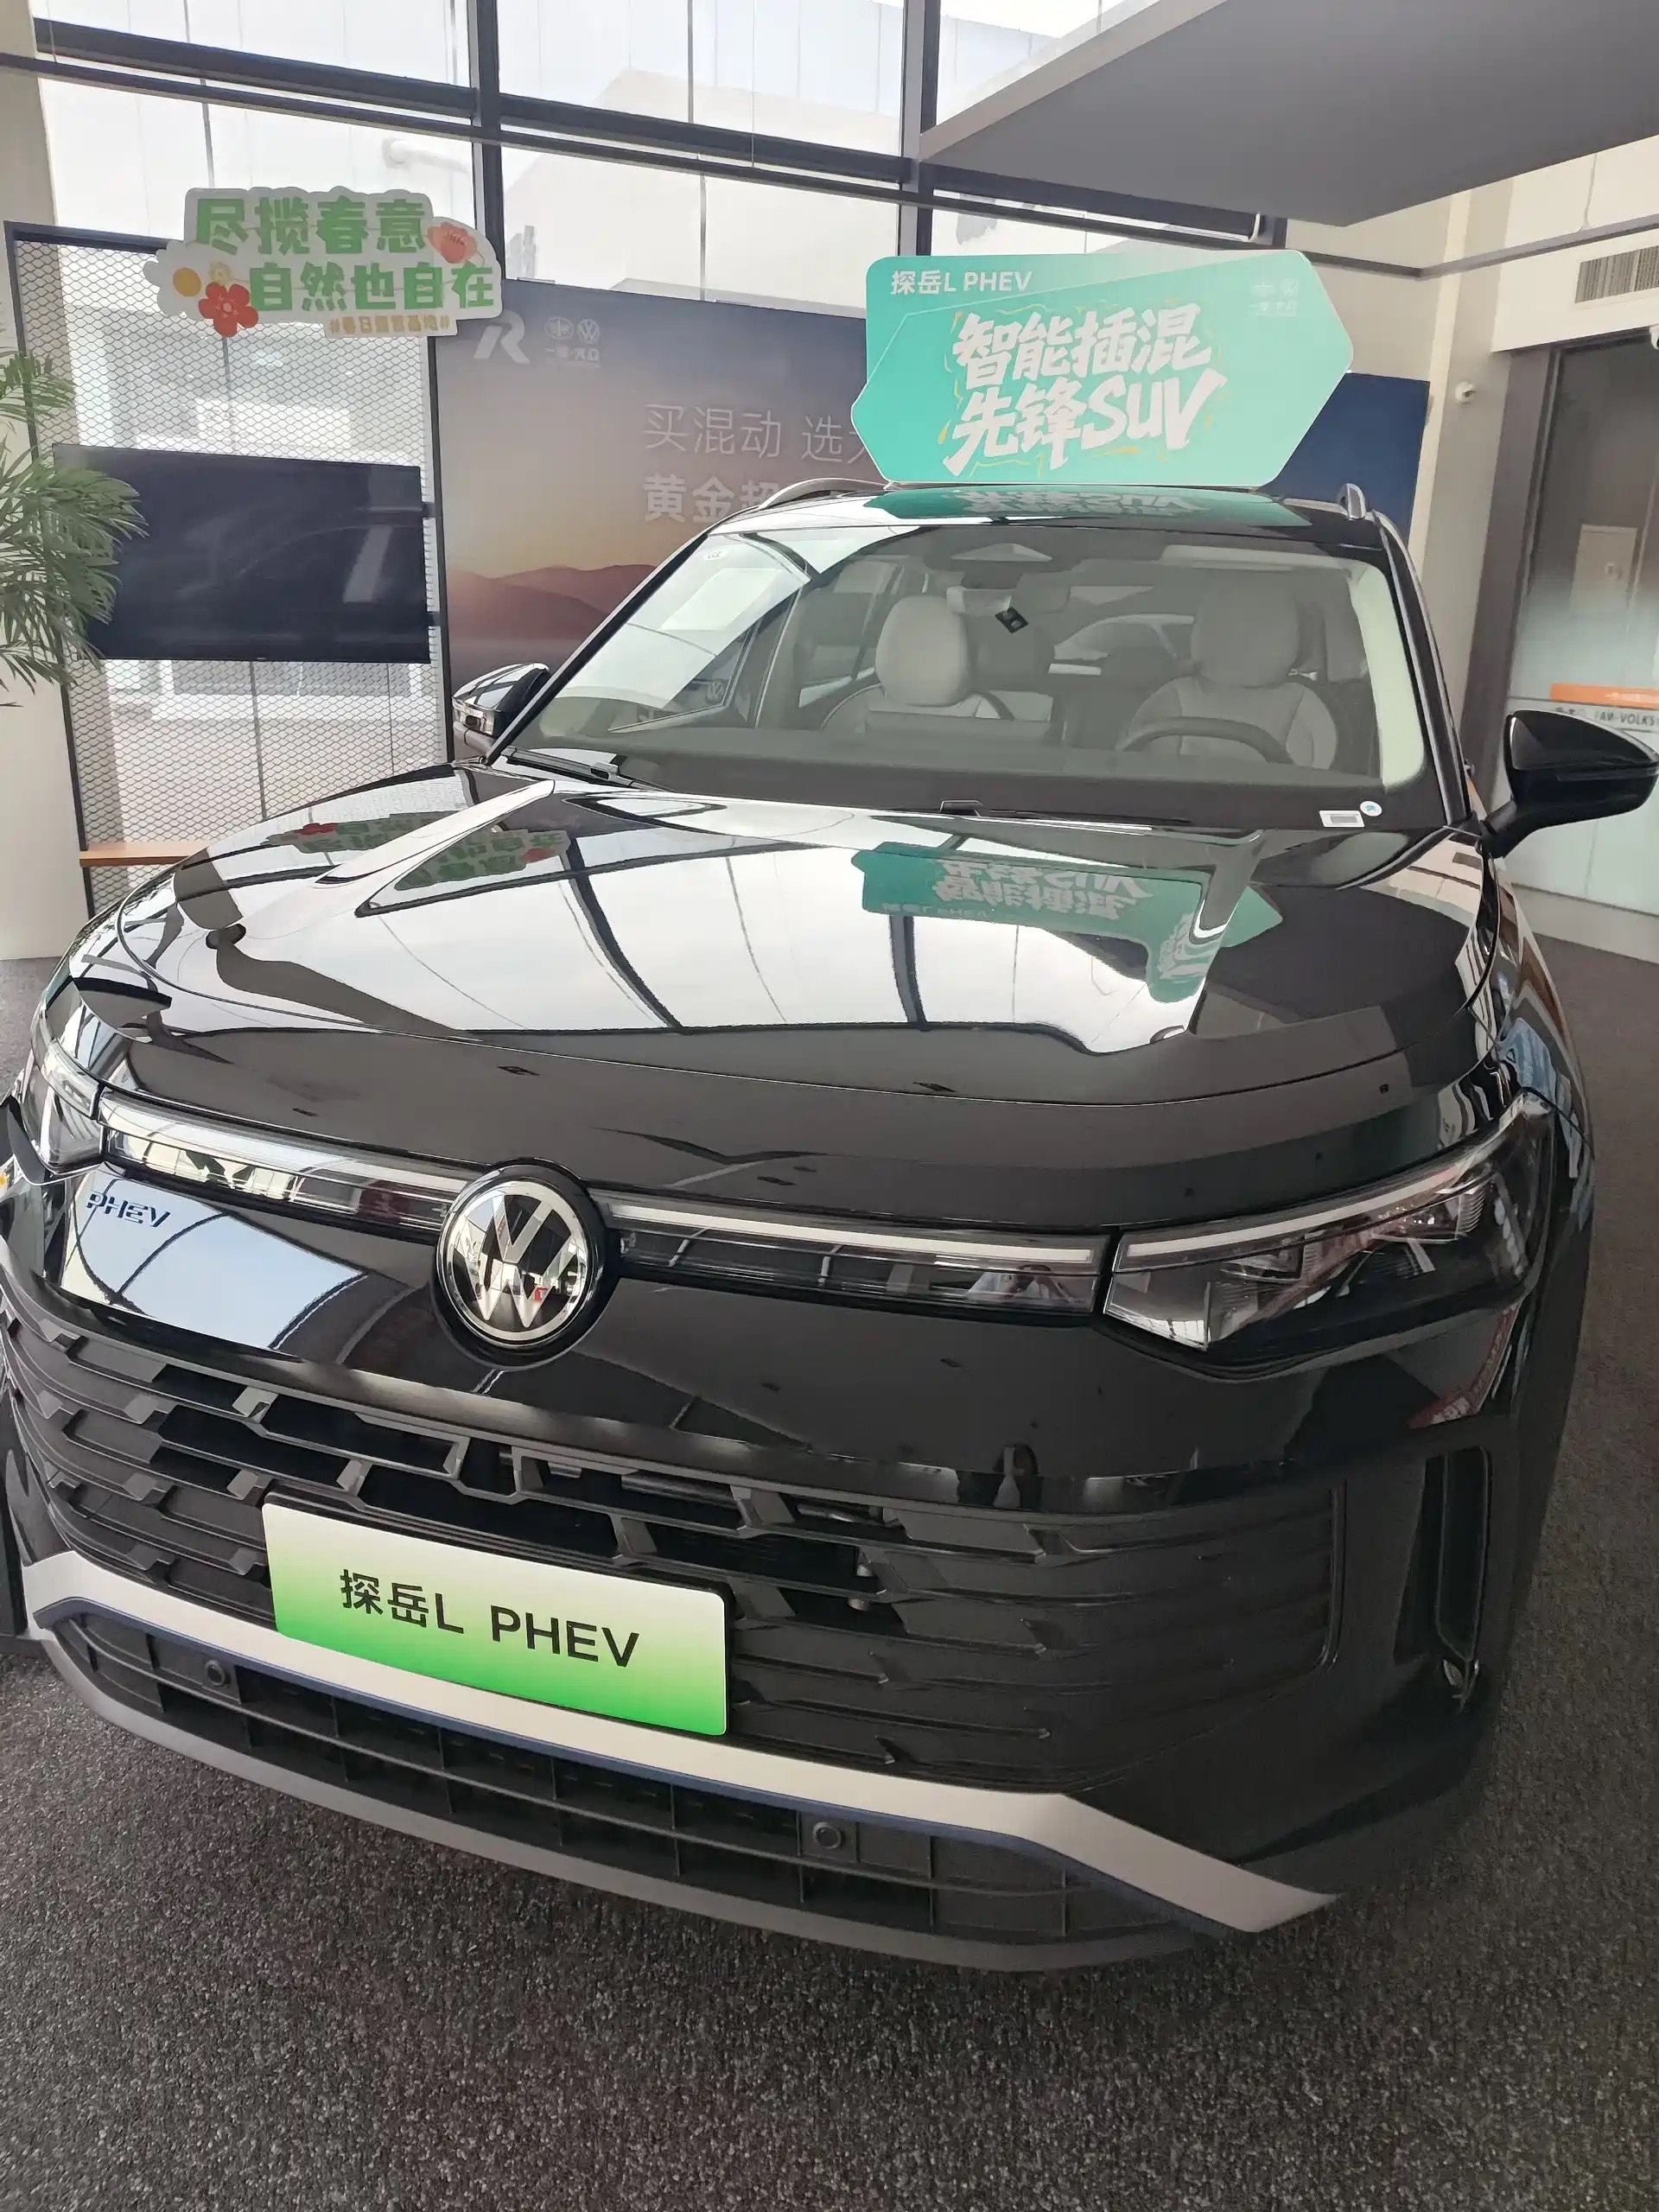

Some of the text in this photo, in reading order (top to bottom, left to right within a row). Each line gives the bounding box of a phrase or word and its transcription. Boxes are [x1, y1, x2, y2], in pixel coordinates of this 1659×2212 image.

[198, 197, 427, 255] 尽揽春意
[249, 261, 494, 311] 自然也自在
[891, 269, 1033, 296] 探岳L PHEV
[952, 303, 1211, 389] 智能插混
[644, 404, 780, 458] 买混动
[944, 369, 1227, 476] 先锋SUV
[87, 1190, 171, 1228] PHEV
[340, 1568, 639, 1669] 探岳L PHEV
